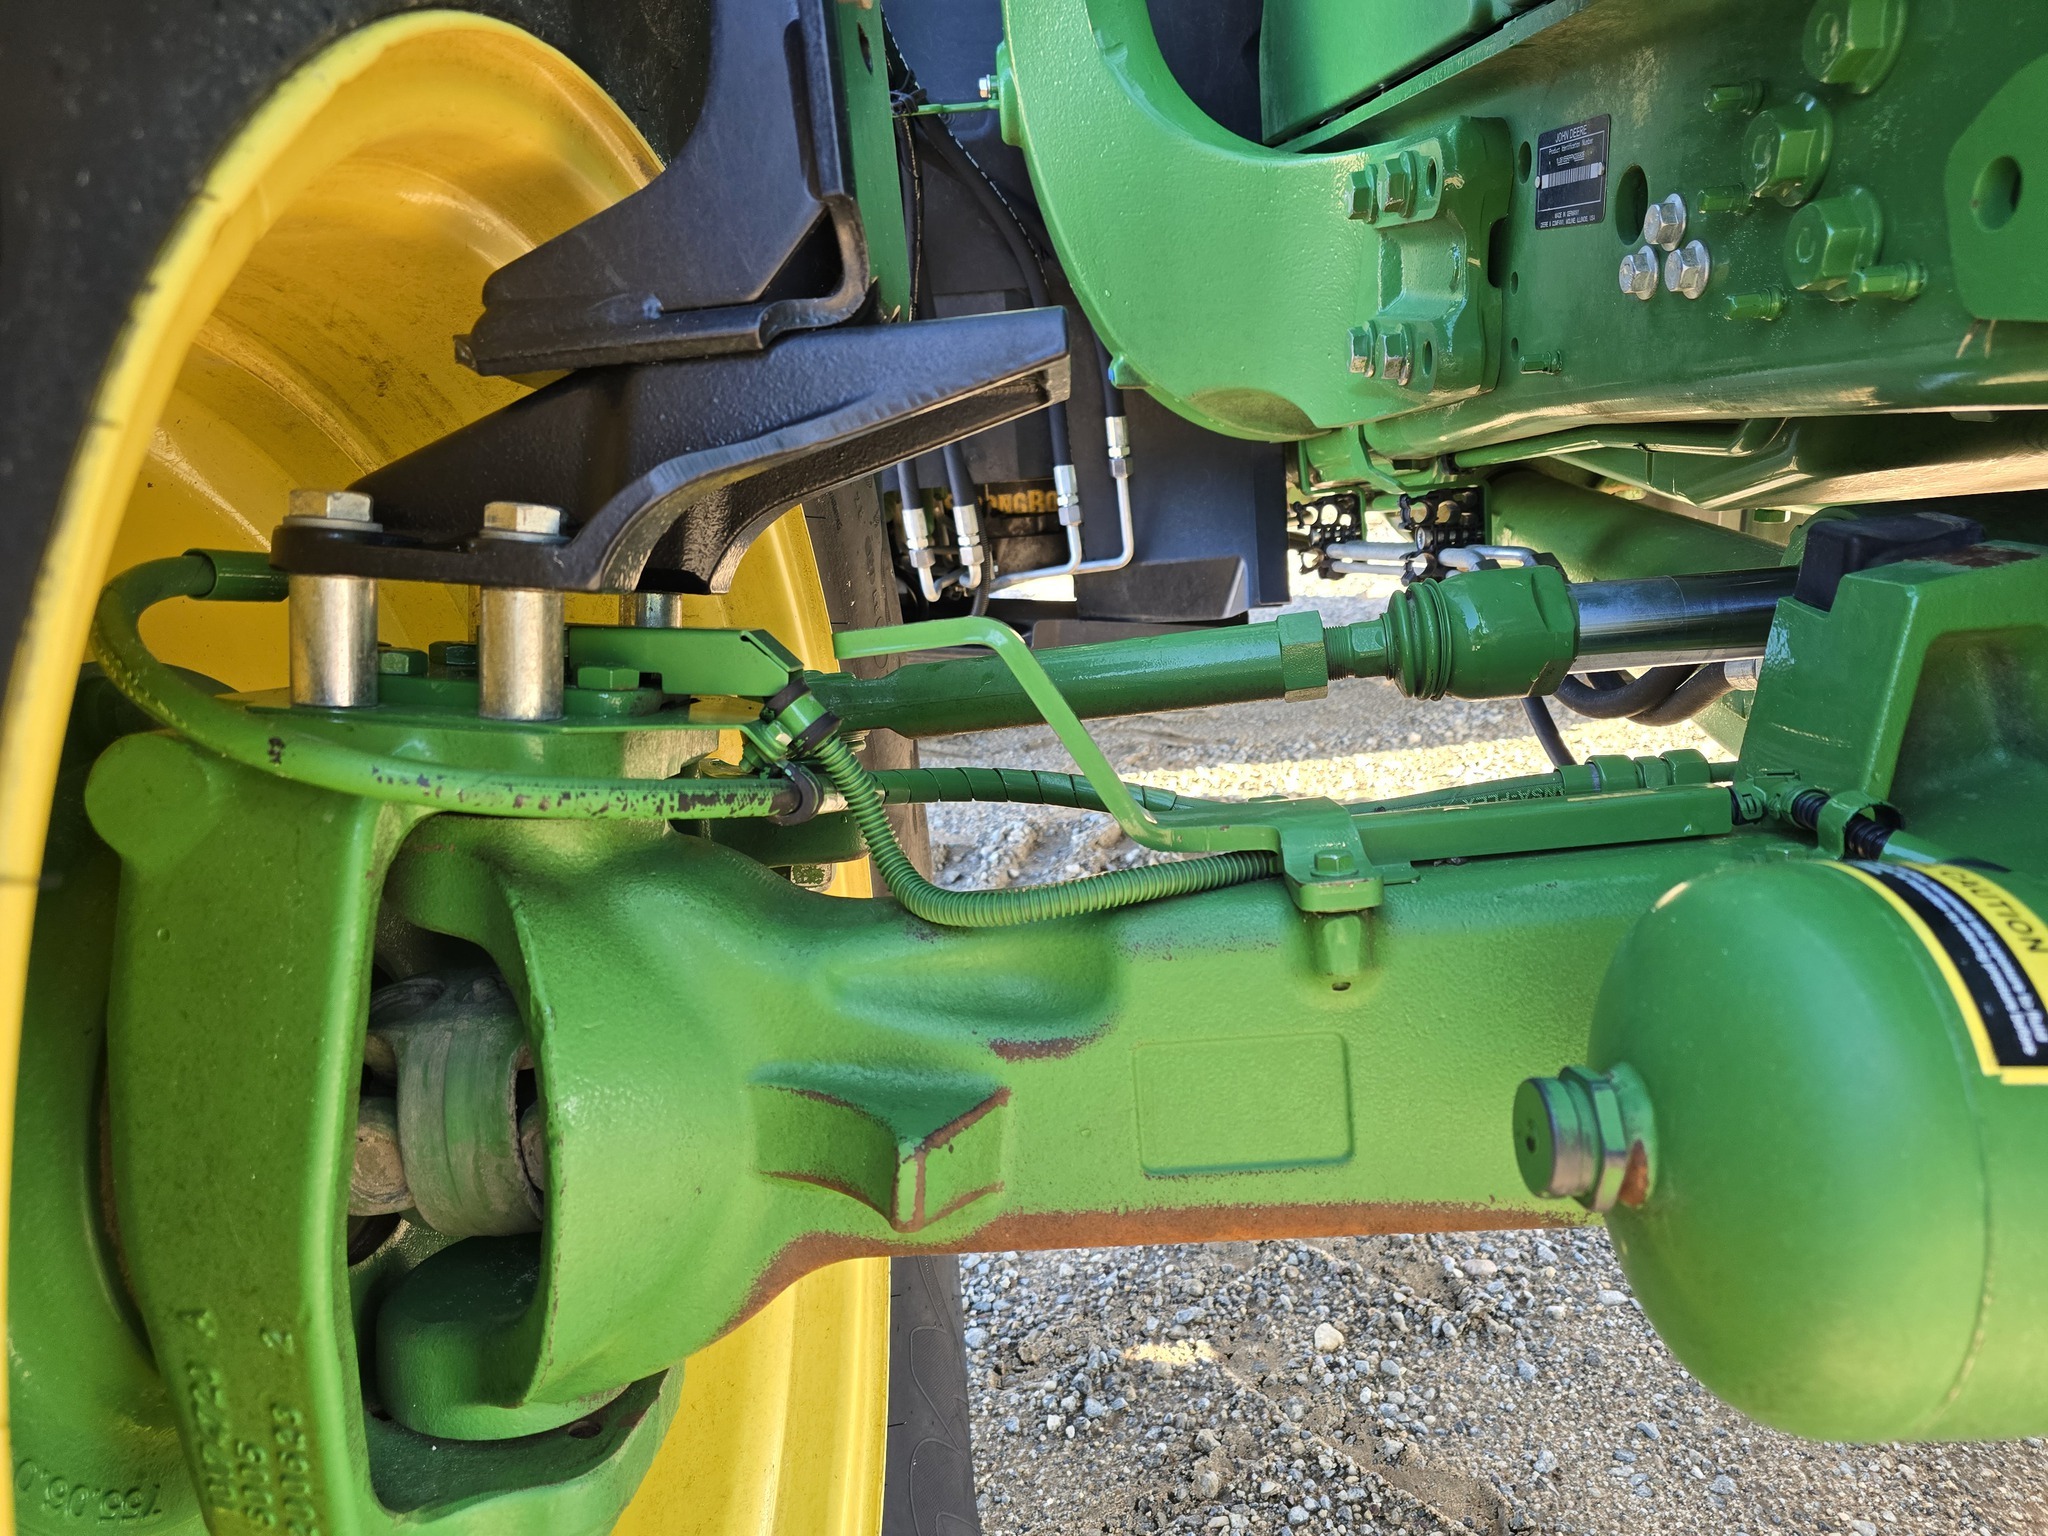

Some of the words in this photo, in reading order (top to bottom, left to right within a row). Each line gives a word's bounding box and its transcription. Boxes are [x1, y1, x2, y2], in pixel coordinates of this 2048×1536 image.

[1555, 129, 1570, 143] JOHN
[1569, 124, 1588, 138] DEERE
[1548, 146, 1561, 156] Product
[1561, 141, 1581, 153] Identification
[1581, 138, 1594, 147] Number
[1940, 868, 2048, 953] CAUTION
